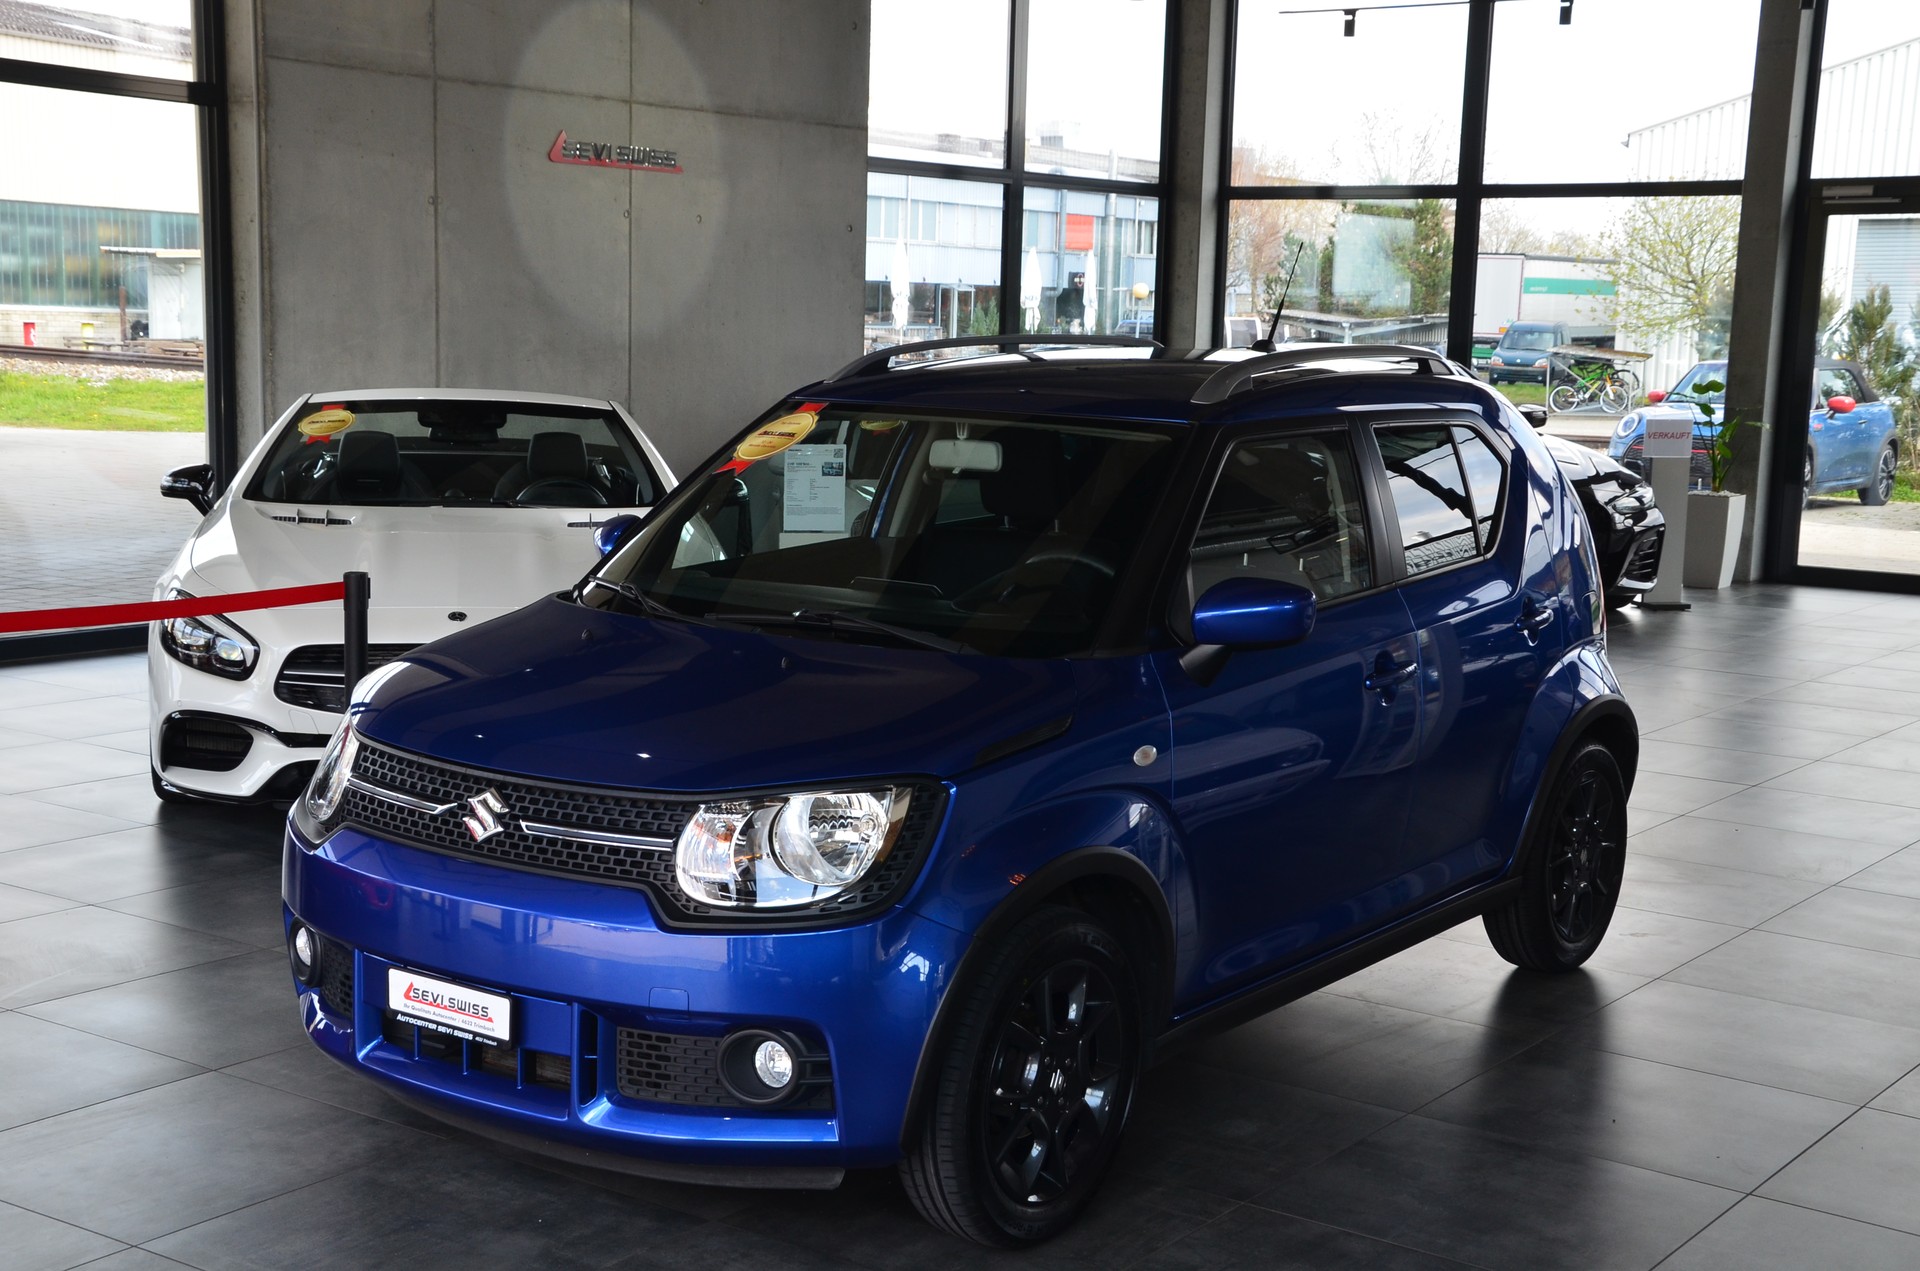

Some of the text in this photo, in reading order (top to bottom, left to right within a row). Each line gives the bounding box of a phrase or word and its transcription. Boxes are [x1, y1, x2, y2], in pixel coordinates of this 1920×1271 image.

[562, 139, 677, 168] SEVI SWISS
[1648, 432, 1691, 440] VERKAUFT
[412, 987, 489, 1018] SEVI SWISS
[437, 1025, 453, 1035] SEVI
[453, 1030, 473, 1040] SWISS
